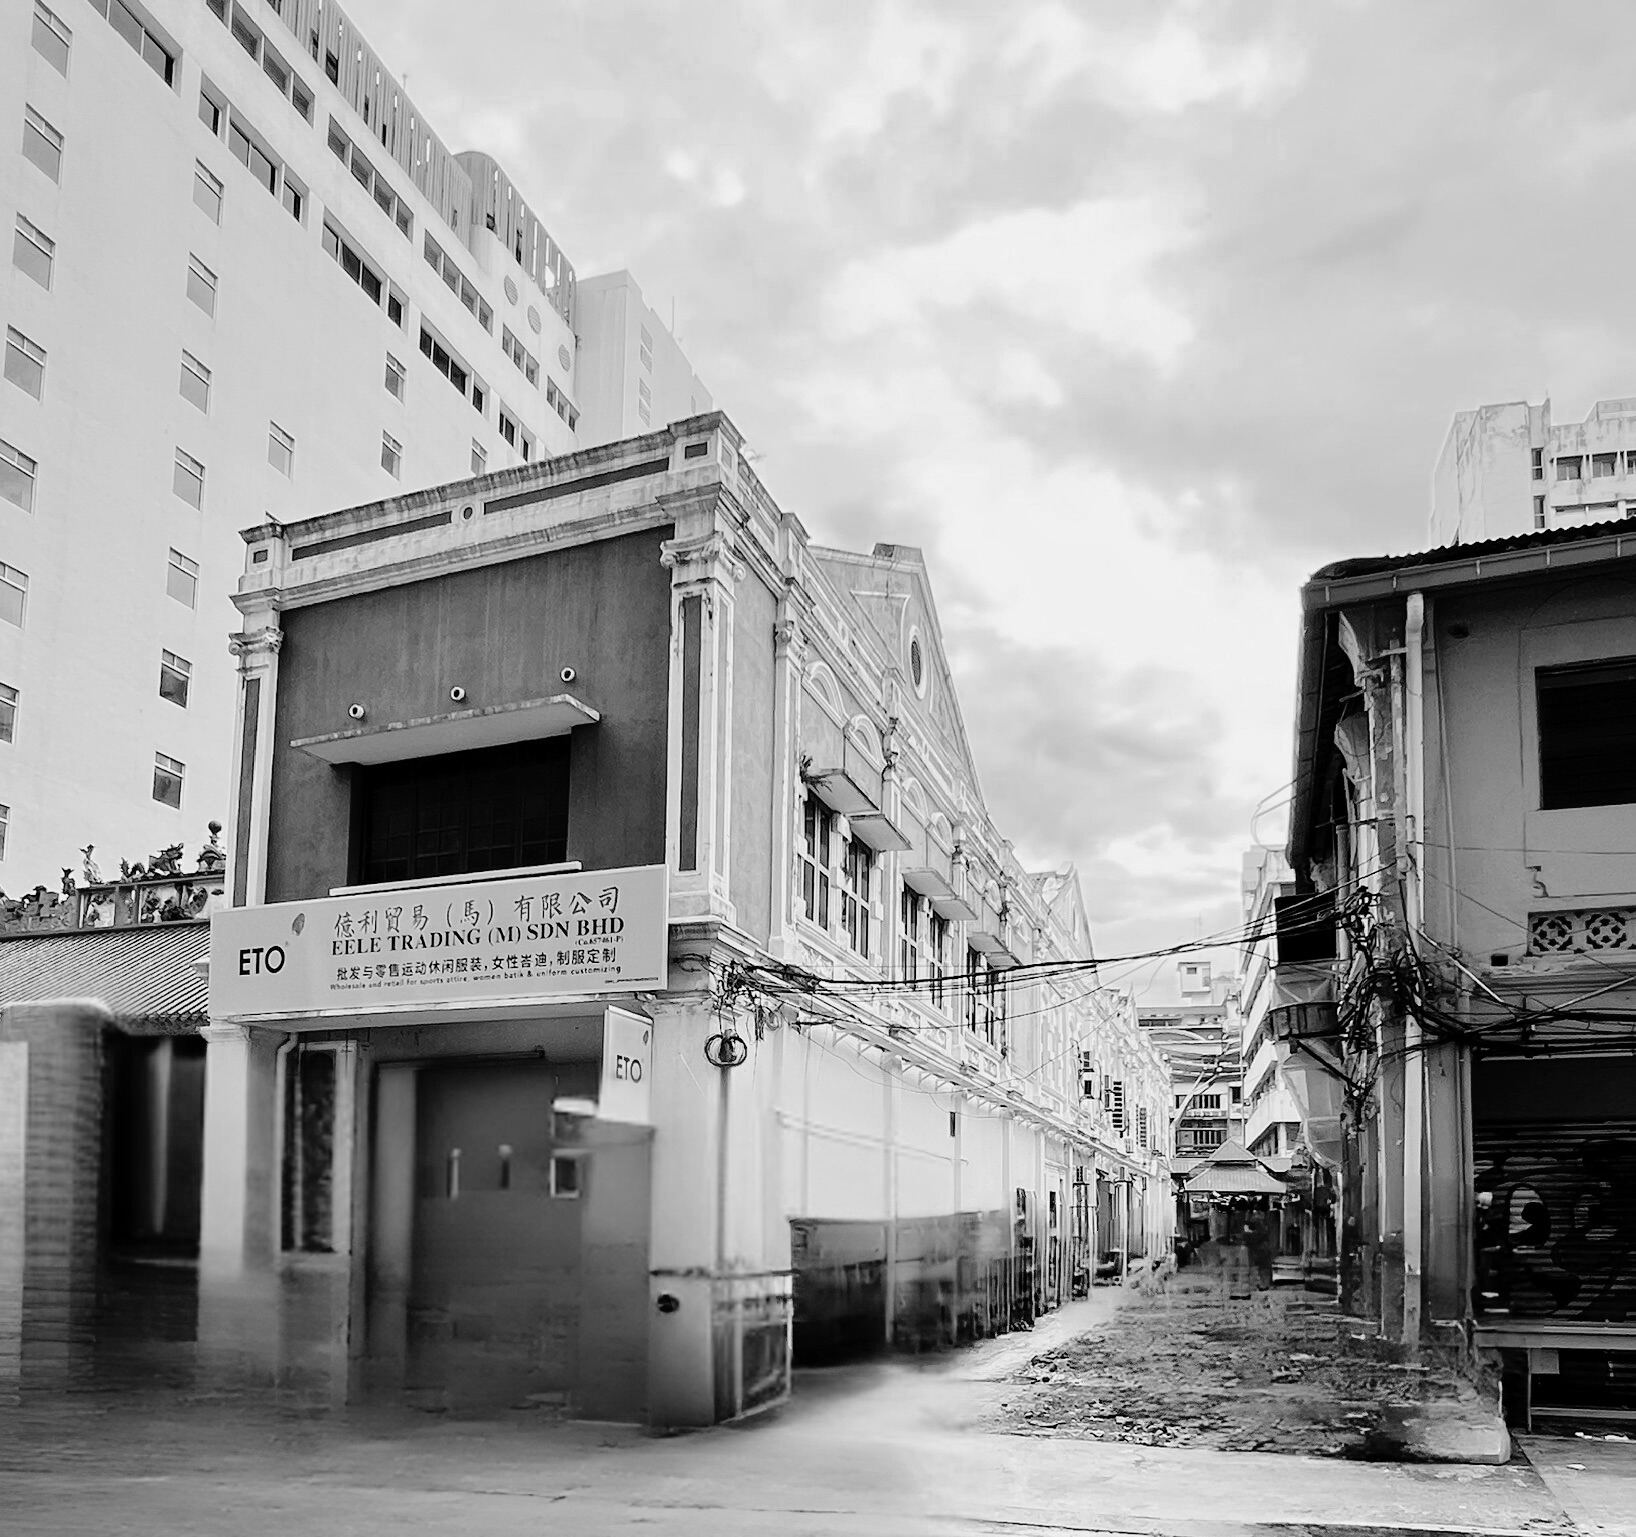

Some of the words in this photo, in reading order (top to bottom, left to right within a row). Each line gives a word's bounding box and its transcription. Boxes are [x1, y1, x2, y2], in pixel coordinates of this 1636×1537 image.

[332, 937, 381, 956] EELE
[387, 928, 481, 951] TRADING
[488, 925, 521, 946] (M)
[526, 920, 570, 941] SDN
[576, 916, 624, 937] BHD
[239, 945, 285, 976] ETO
[368, 980, 382, 988] and
[384, 978, 404, 987] retail
[406, 977, 418, 986] for
[420, 976, 444, 986] sports
[473, 973, 501, 982] women
[504, 971, 524, 980] batik
[526, 969, 533, 978] &
[536, 967, 568, 978] uniform
[570, 964, 622, 976] customizing
[616, 1054, 642, 1084] ETO
